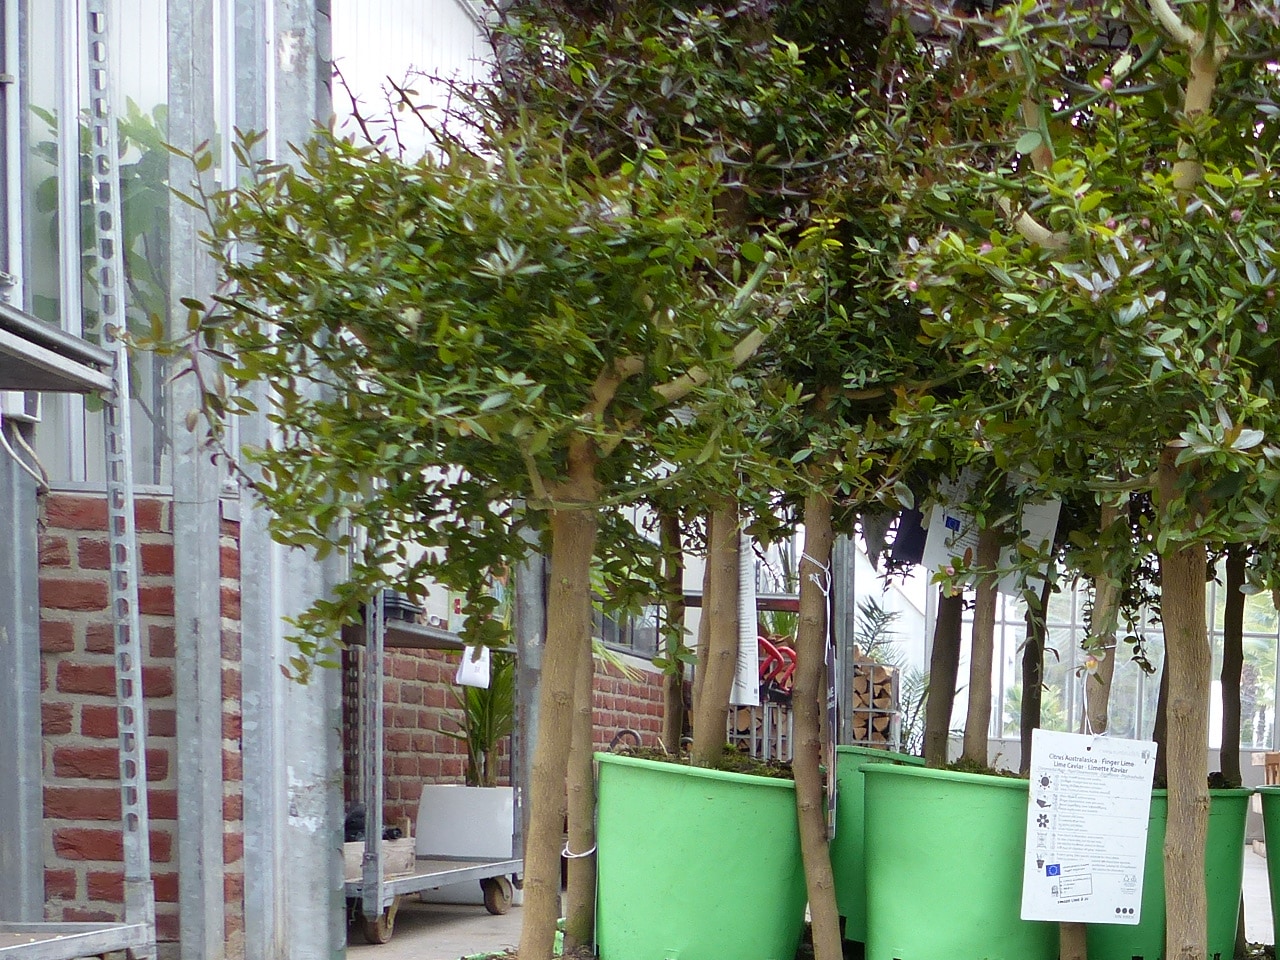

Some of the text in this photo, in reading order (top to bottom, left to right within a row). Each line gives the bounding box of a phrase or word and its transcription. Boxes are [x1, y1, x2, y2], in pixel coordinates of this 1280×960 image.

[1048, 753, 1064, 761] Citrus
[1065, 755, 1097, 764] Australasica
[1101, 758, 1120, 767] Finger
[1087, 765, 1109, 773] Limette
[1110, 766, 1128, 774] Kaviar
